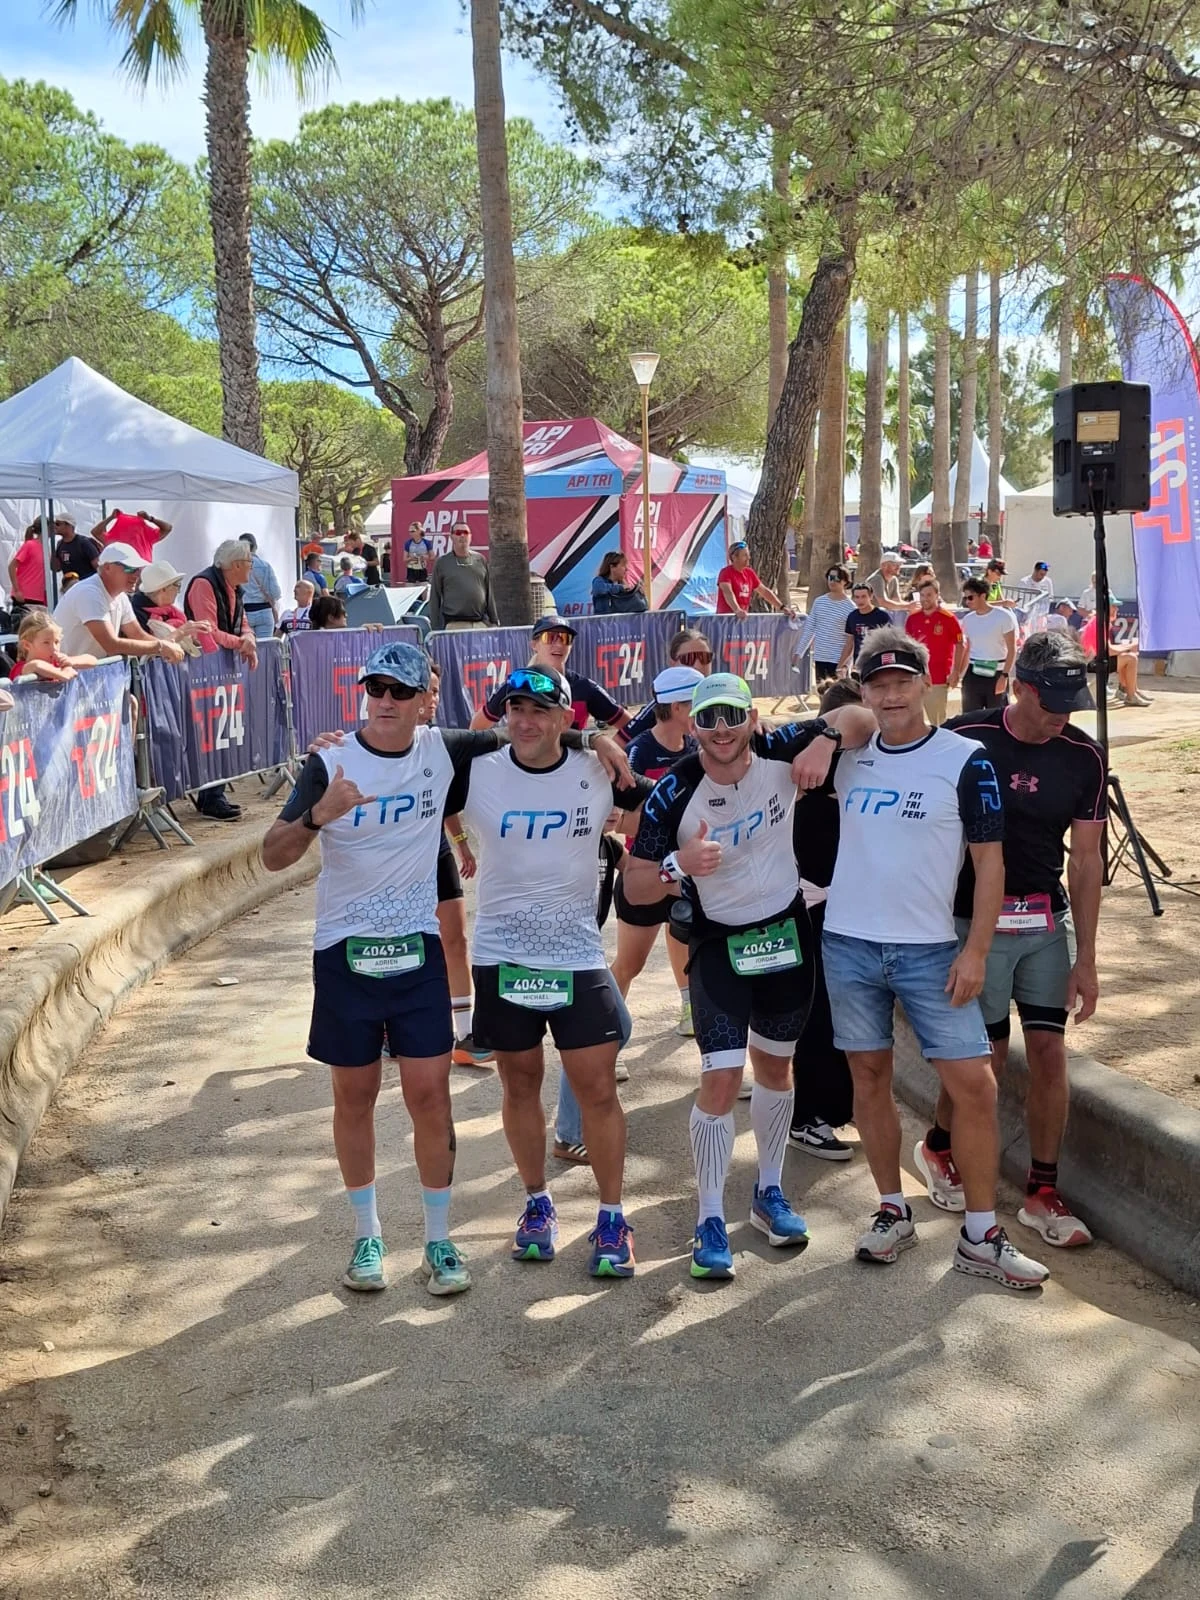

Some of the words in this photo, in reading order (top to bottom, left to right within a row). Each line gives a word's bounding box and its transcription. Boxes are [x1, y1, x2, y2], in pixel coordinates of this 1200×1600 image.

[525, 424, 573, 442] API
[567, 476, 590, 489] API
[592, 474, 613, 487] TRI
[634, 501, 662, 524] API
[422, 510, 459, 533] API
[564, 603, 585, 616] API
[972, 760, 1001, 809] FTP
[422, 790, 433, 799] FIT
[645, 774, 678, 822] FTP
[769, 793, 778, 808] FIT
[845, 788, 900, 814] FTP
[908, 792, 924, 800] FIT
[354, 794, 415, 827] FTP
[422, 799, 433, 809] TRI
[576, 806, 589, 816] FIT
[769, 803, 781, 817] TRI
[906, 801, 921, 809] TRI
[421, 808, 437, 819] PERF
[901, 810, 927, 820] PERF
[500, 811, 568, 839] FTP
[576, 817, 588, 826] TRI
[711, 811, 763, 846] FTP
[1014, 901, 1028, 912] 22
[362, 943, 408, 956] 4049-1
[743, 938, 786, 955] 4049-2
[513, 978, 559, 991] 4049-4
